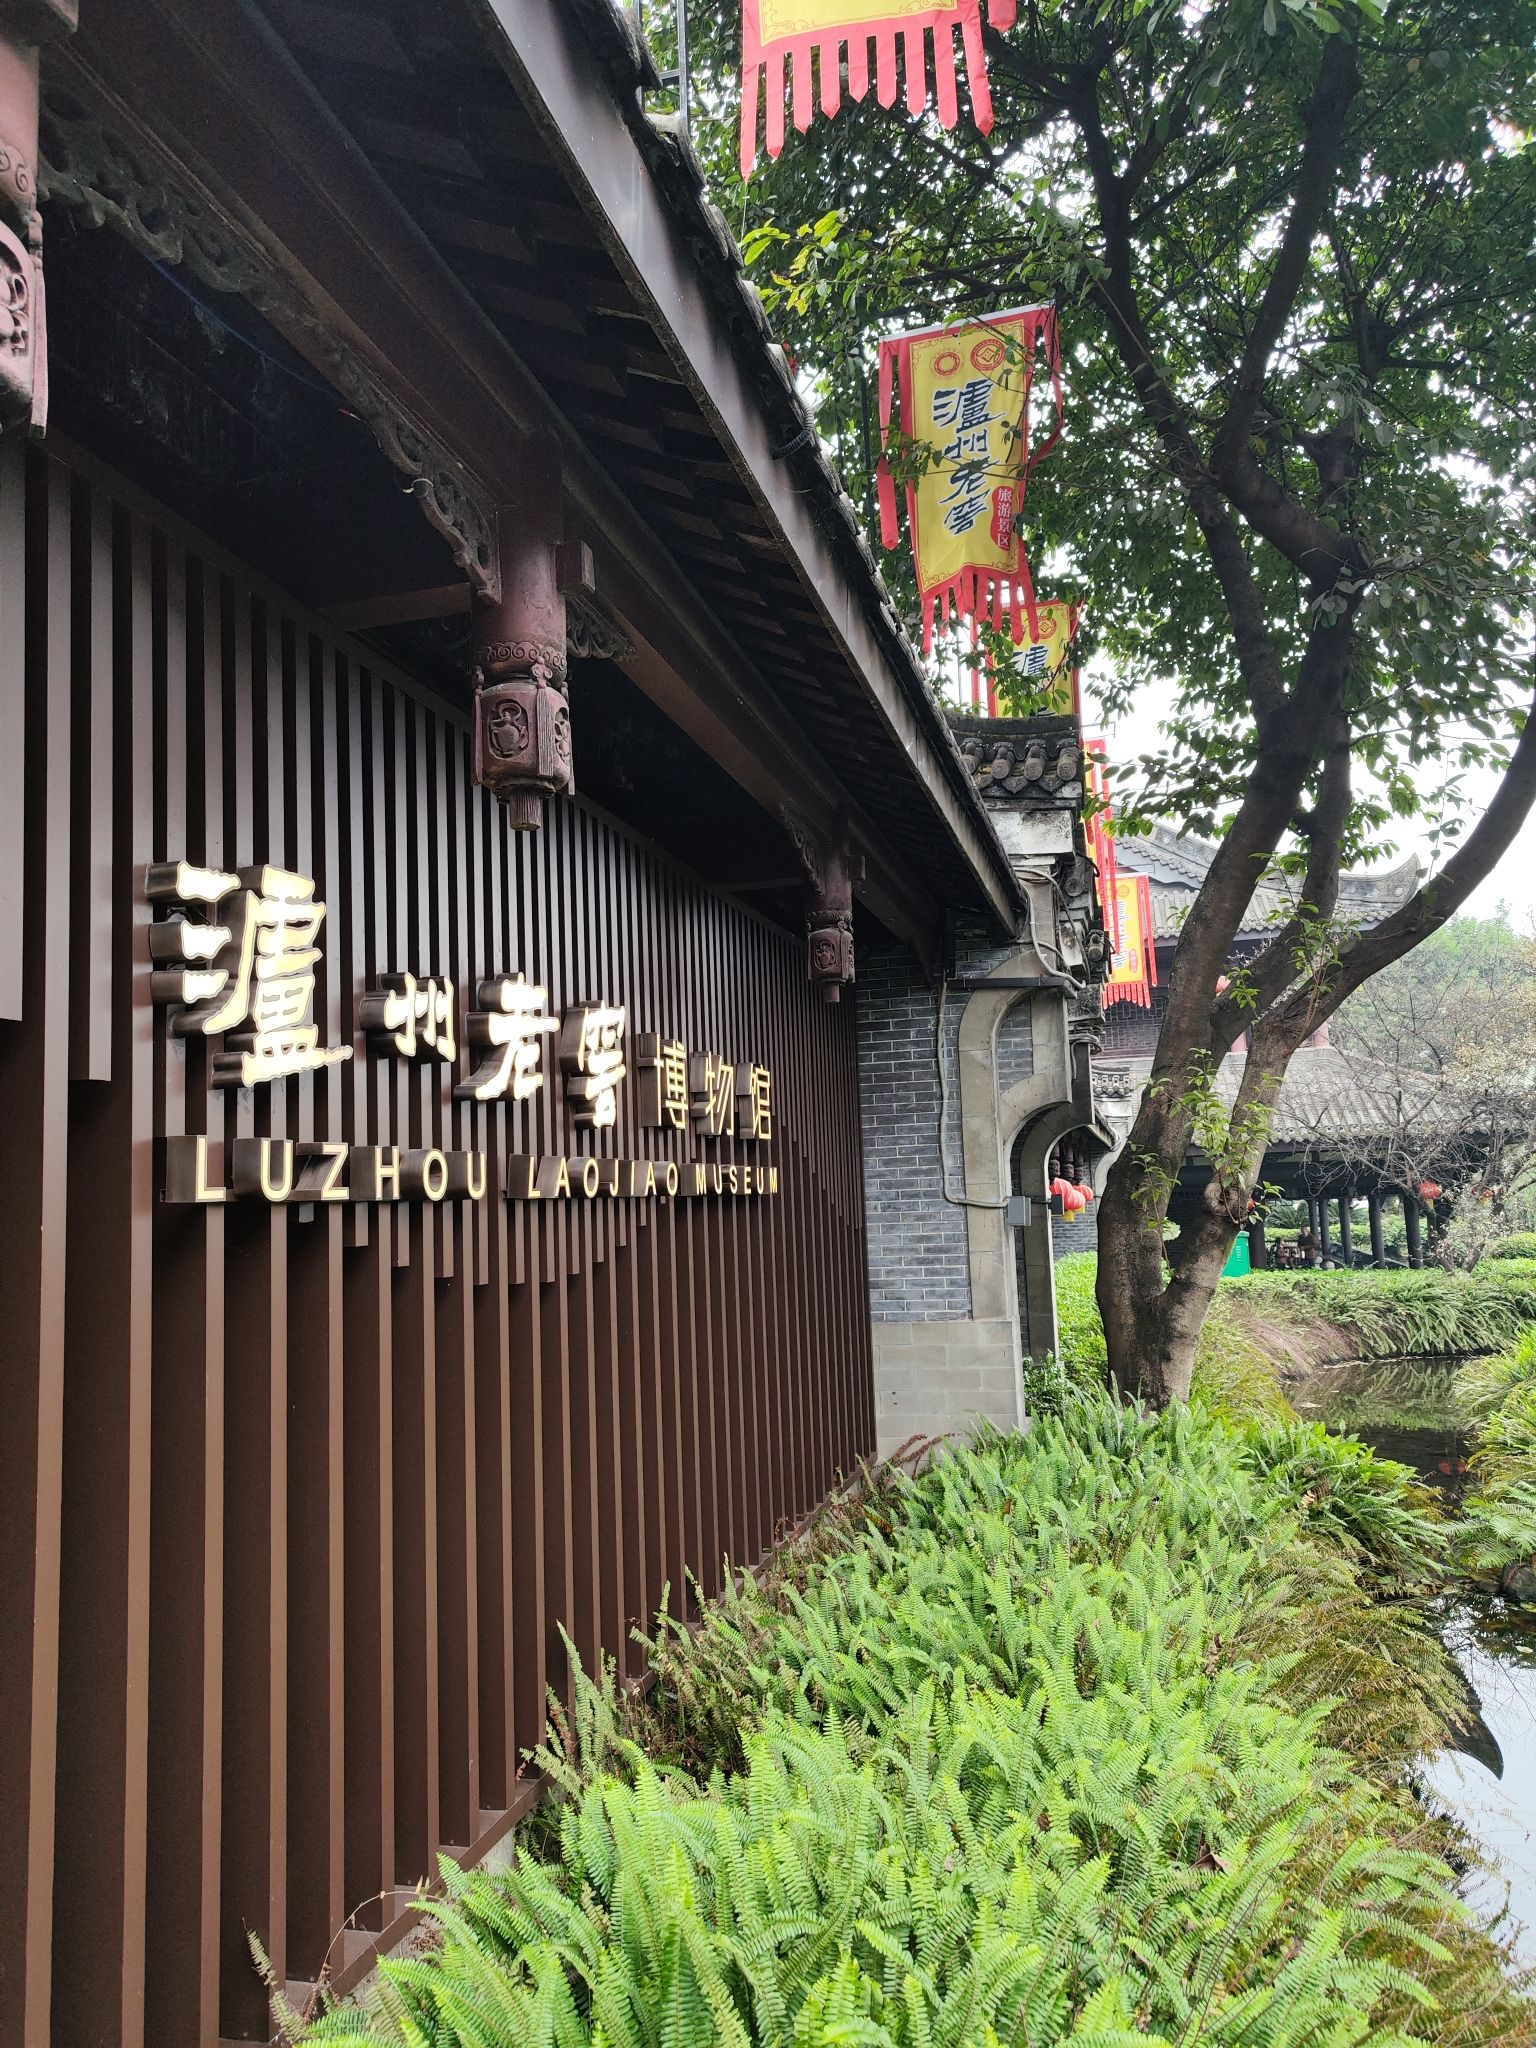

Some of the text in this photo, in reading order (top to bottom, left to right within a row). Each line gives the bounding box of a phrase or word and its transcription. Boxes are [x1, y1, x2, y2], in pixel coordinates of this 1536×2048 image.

[195, 1134, 778, 1202] LUZHOU LAOJIAO MUSEUM
